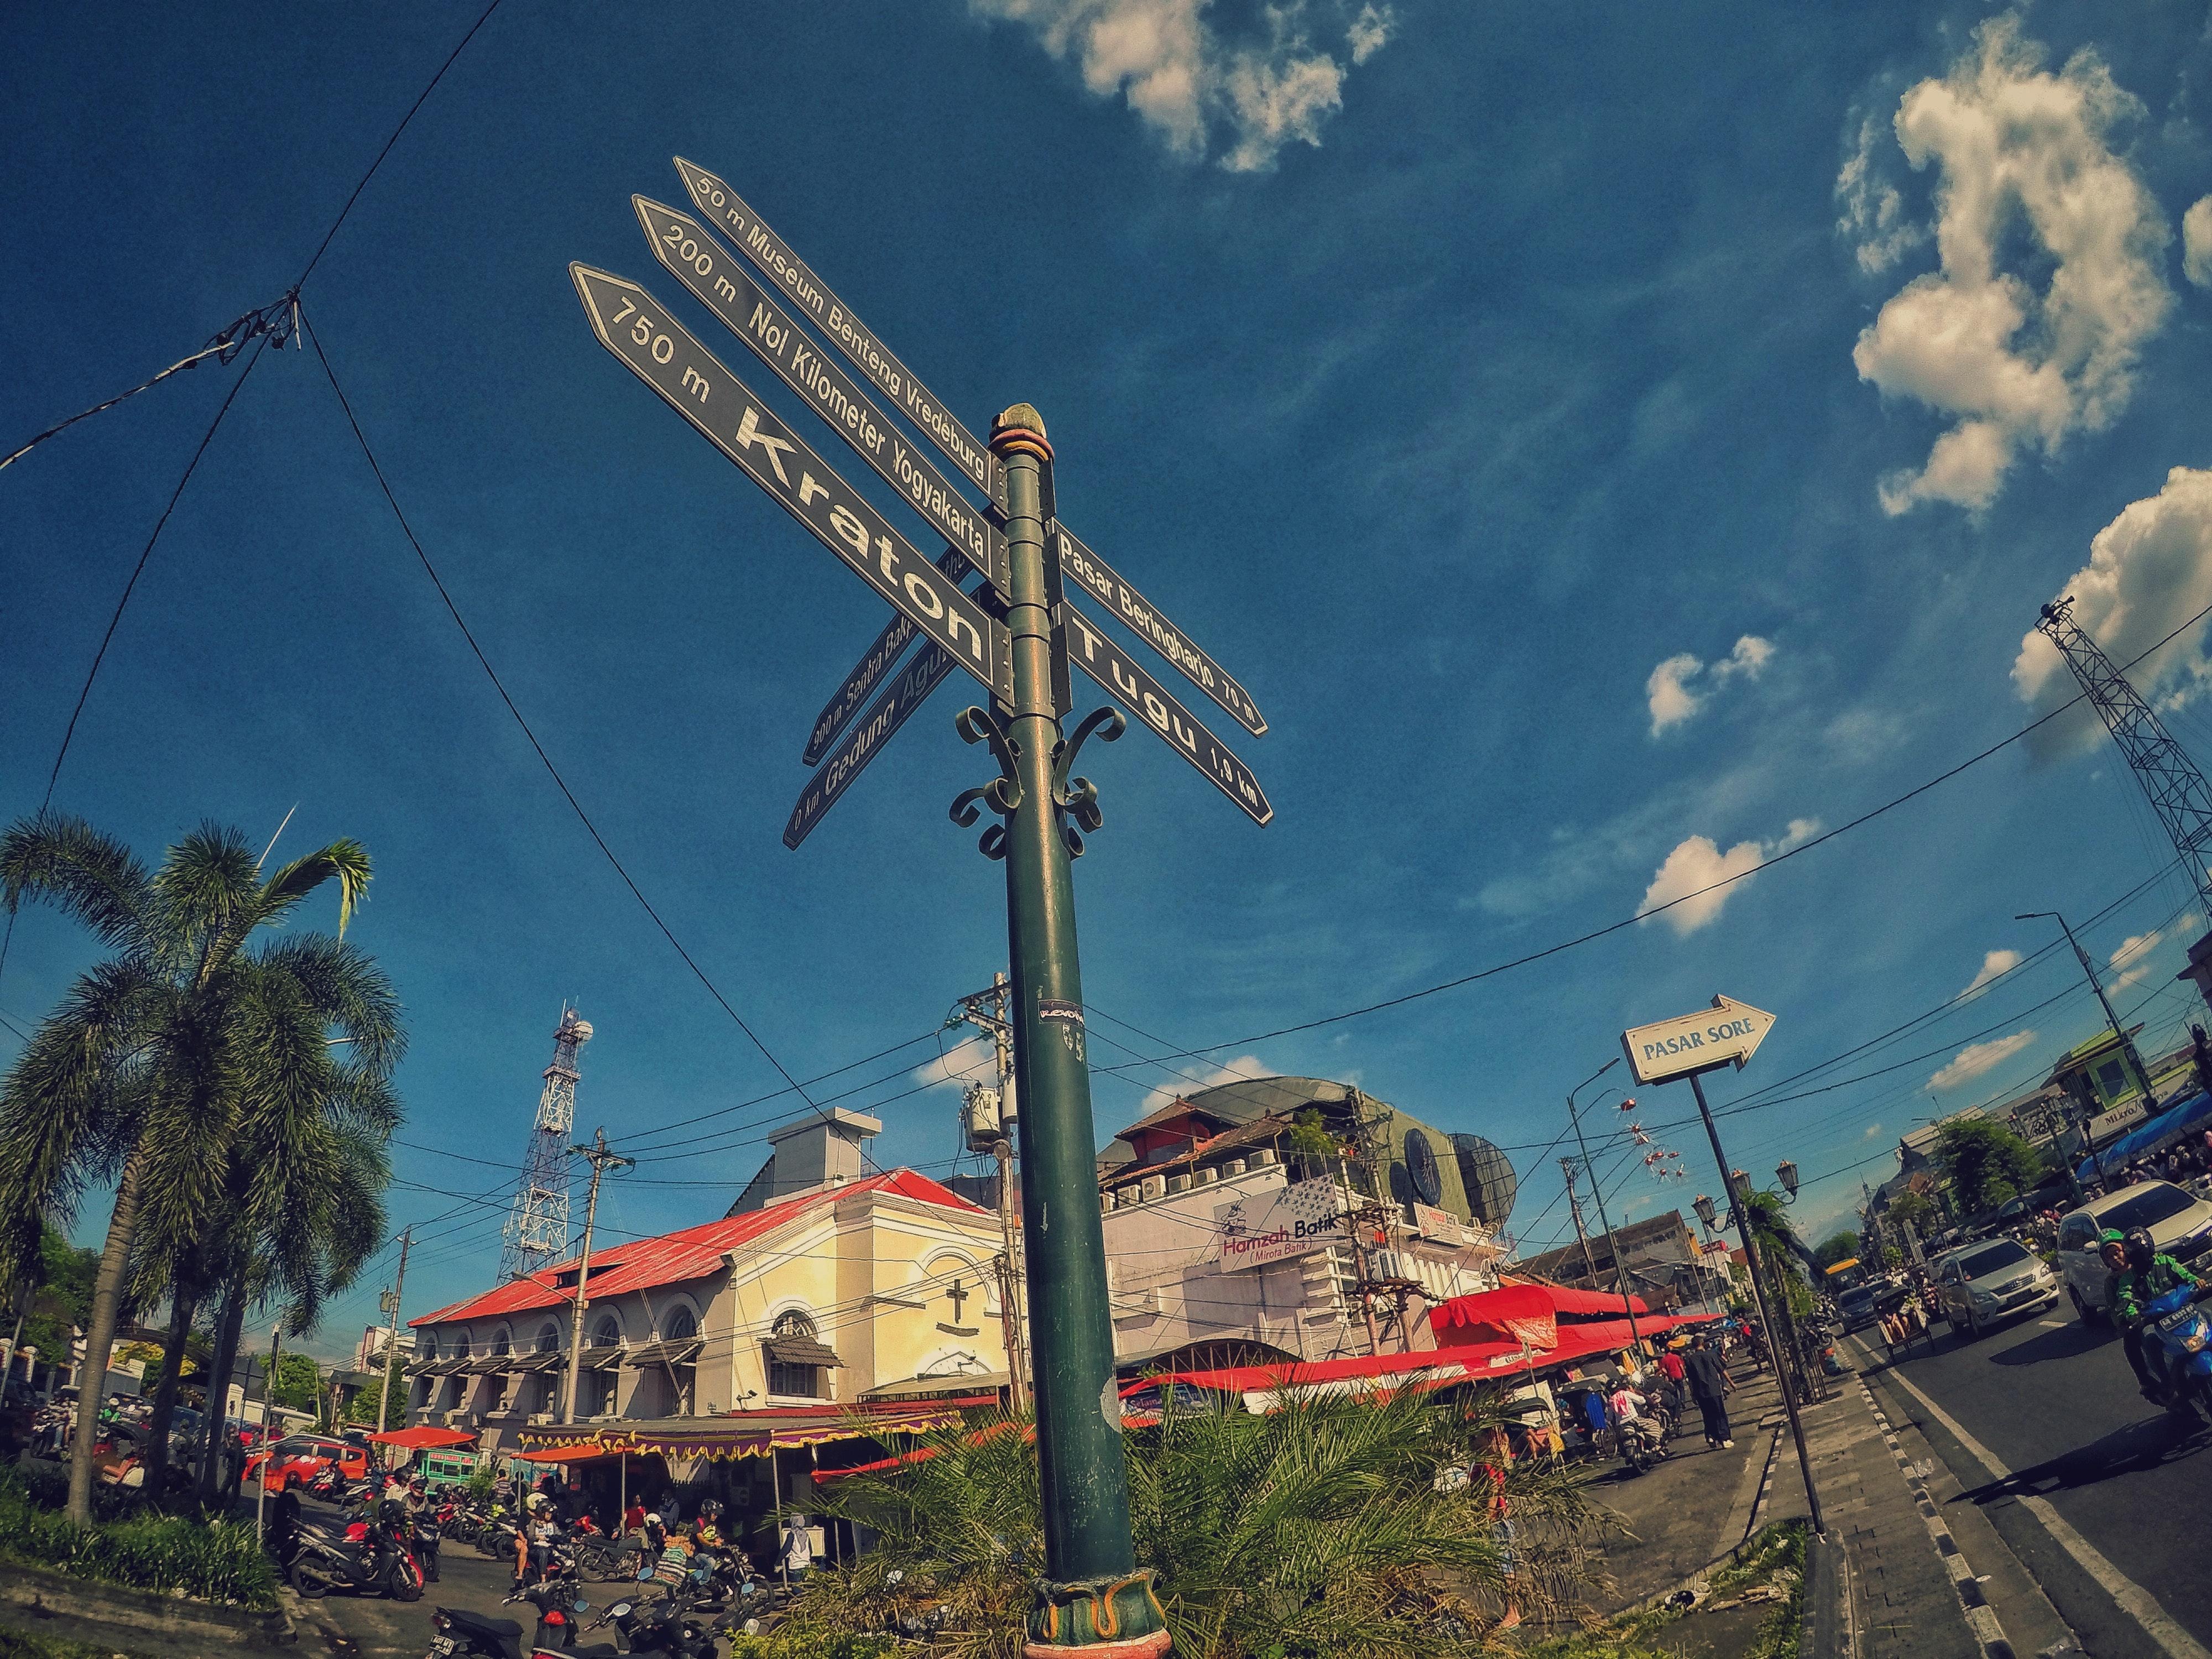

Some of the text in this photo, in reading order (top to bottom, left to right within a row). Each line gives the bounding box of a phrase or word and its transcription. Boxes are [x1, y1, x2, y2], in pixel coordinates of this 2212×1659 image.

[662, 225, 984, 559] 200 m Nol Kilometer Yogyakarta
[697, 177, 984, 481] 50 m Museum Benteng Vredeburg
[612, 296, 982, 661] 750 m Kraton
[813, 714, 832, 750] 900
[833, 705, 842, 722] m
[846, 651, 881, 711] Sentra
[1059, 532, 1255, 723] Pasar Beringharjo 70 m
[1072, 615, 1258, 807] Tugu 1,9 km
[794, 807, 802, 832] 0
[805, 791, 820, 820] km
[825, 698, 895, 796] Gedung
[1643, 1018, 1755, 1060] PASAR SORE
[1223, 1213, 1338, 1256] Hamzah Batik
